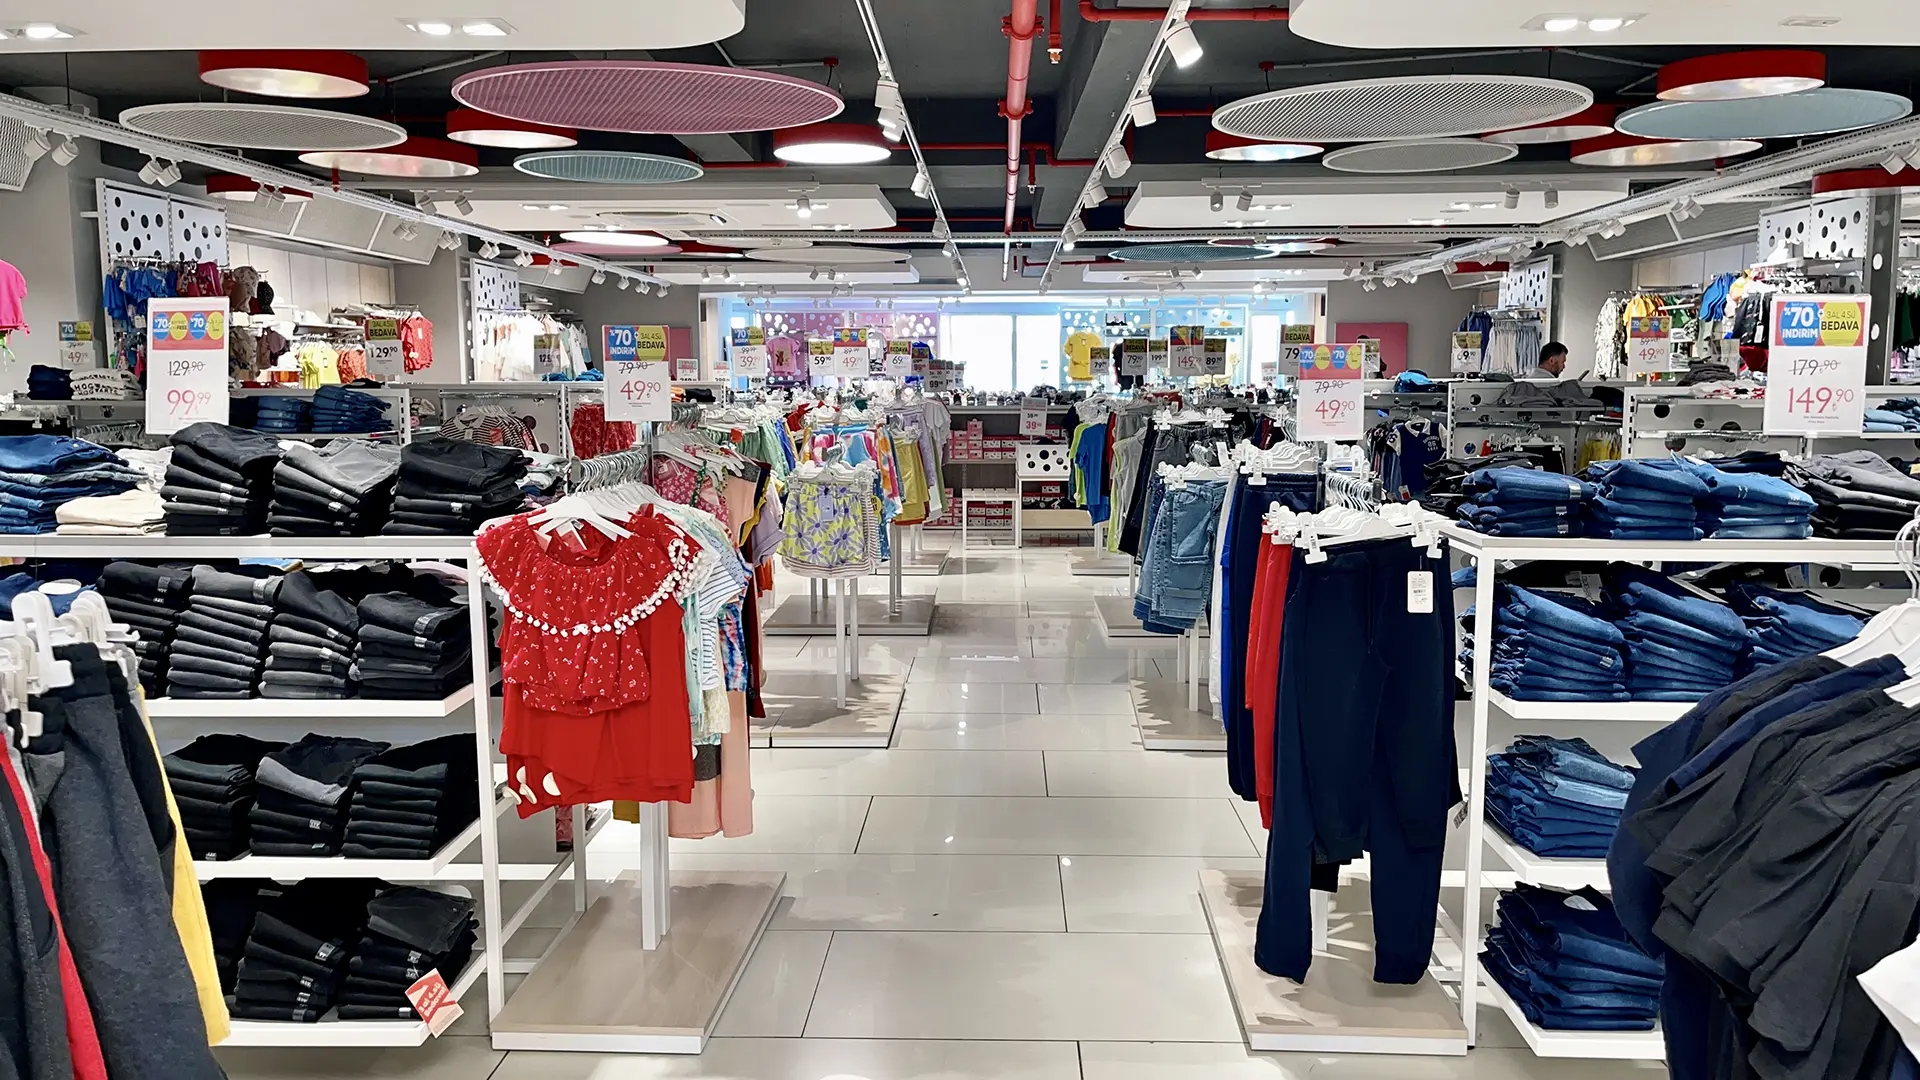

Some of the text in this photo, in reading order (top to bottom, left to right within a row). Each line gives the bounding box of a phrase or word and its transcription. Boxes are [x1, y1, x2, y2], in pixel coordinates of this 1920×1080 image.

[1820, 320, 1860, 331] BEDAVA
[369, 328, 398, 337] BEDAVA
[1284, 332, 1311, 341] BEDAVA
[1782, 328, 1819, 339] İNDİRİM
[637, 340, 666, 350] BEDAVA
[609, 345, 636, 356] İNDİRİM
[418, 1005, 425, 1013] 3
